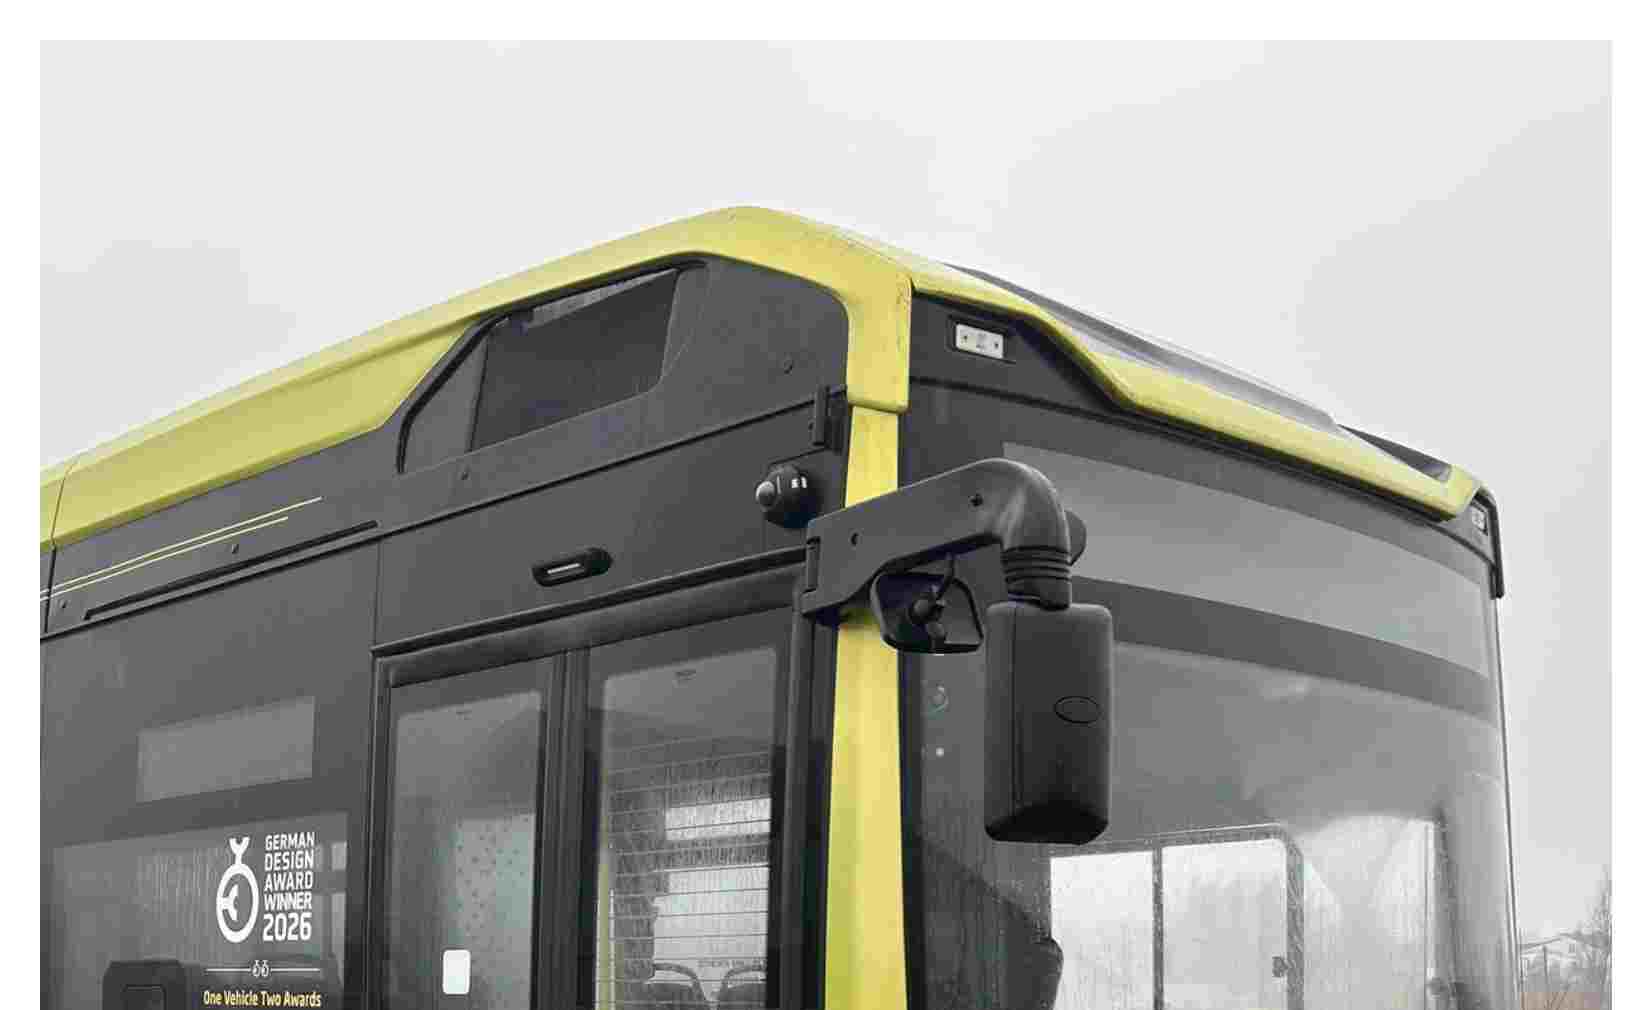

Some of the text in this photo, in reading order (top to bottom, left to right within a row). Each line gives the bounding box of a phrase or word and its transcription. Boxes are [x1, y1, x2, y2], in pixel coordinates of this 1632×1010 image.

[265, 832, 315, 850] GERMAN
[265, 850, 314, 871] DESIGN
[264, 871, 313, 892] AWARD
[264, 892, 312, 910] WINNER
[263, 912, 312, 941] 2026
[203, 990, 322, 1007] One Vehicle Two Awards
